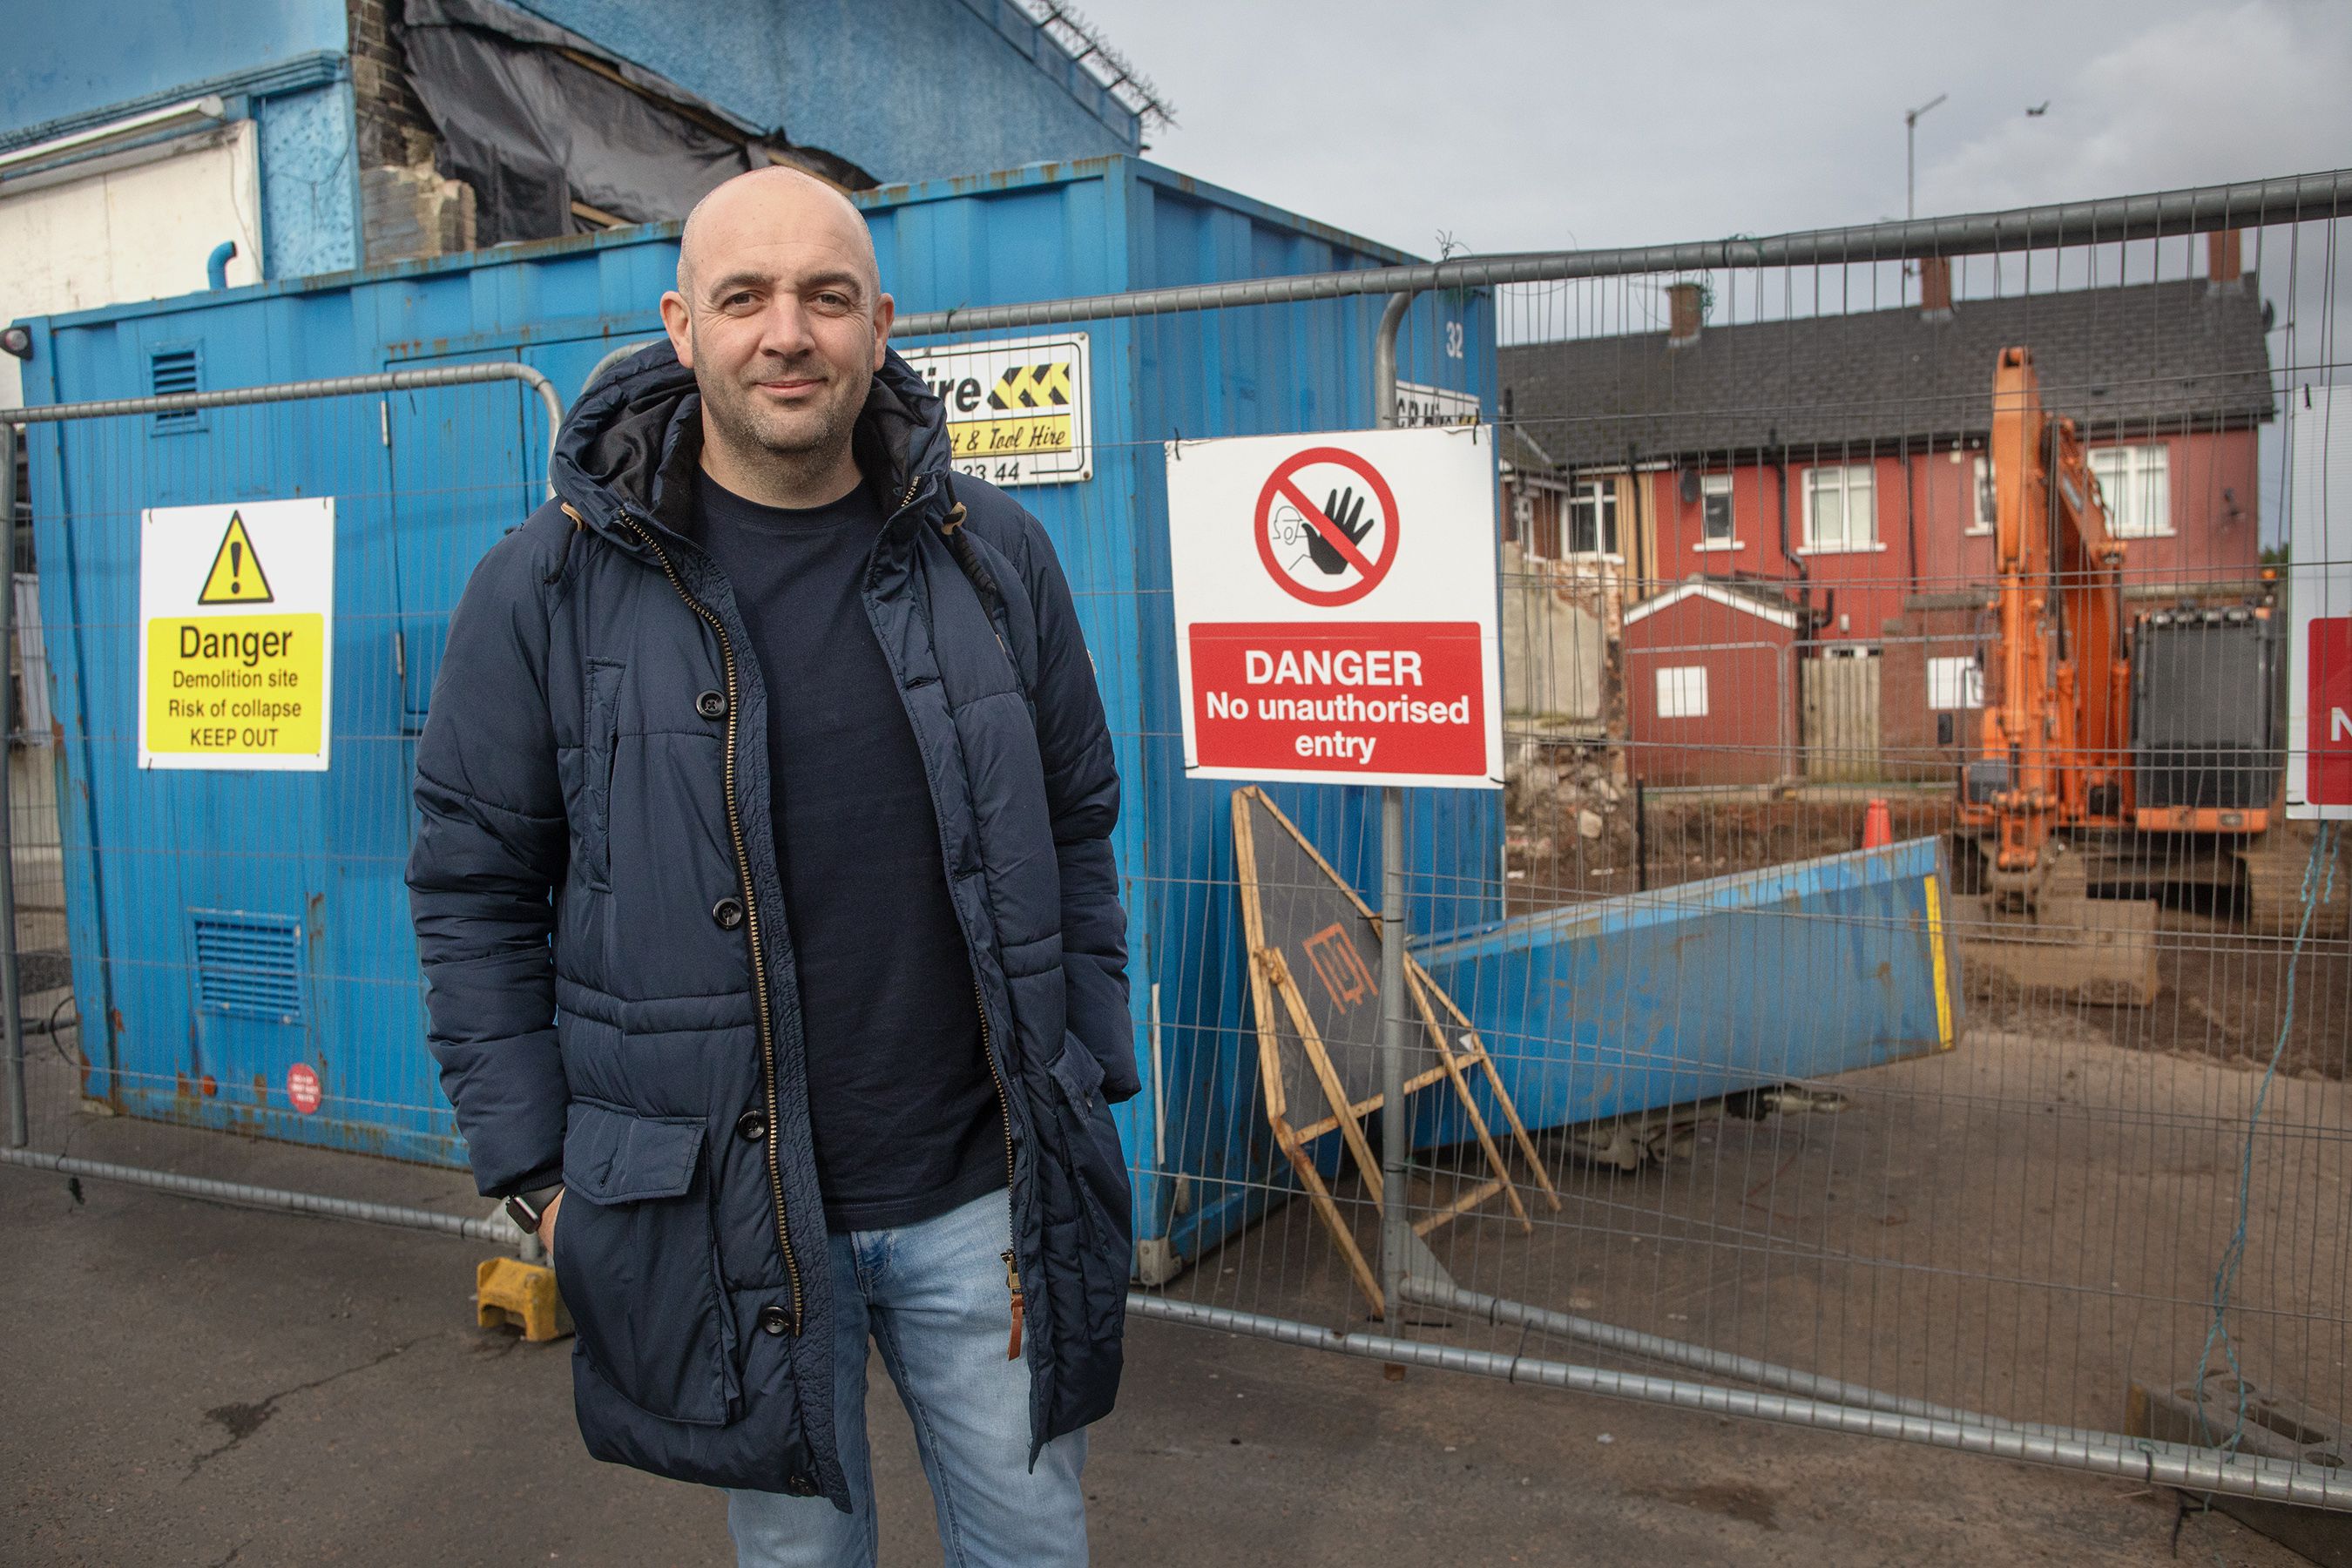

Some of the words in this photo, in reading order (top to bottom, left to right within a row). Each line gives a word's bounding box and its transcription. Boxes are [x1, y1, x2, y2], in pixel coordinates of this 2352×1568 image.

[1446, 320, 1463, 359] 32
[916, 366, 982, 413] ire
[967, 429, 980, 451] &
[990, 425, 1024, 449] Tool
[1029, 422, 1065, 448] Hire
[994, 462, 1019, 481] 44
[179, 625, 293, 666] Danger
[172, 670, 262, 688] Demolition
[268, 668, 299, 687] site
[1245, 650, 1423, 686] DANGER
[169, 700, 205, 718] Risk
[210, 699, 226, 717] of
[232, 700, 301, 720] collapse
[1206, 691, 1249, 720] No
[1258, 693, 1470, 724] unauthorised
[191, 728, 237, 747] KEEP
[242, 728, 279, 747] OUT
[1294, 731, 1376, 764] entry
